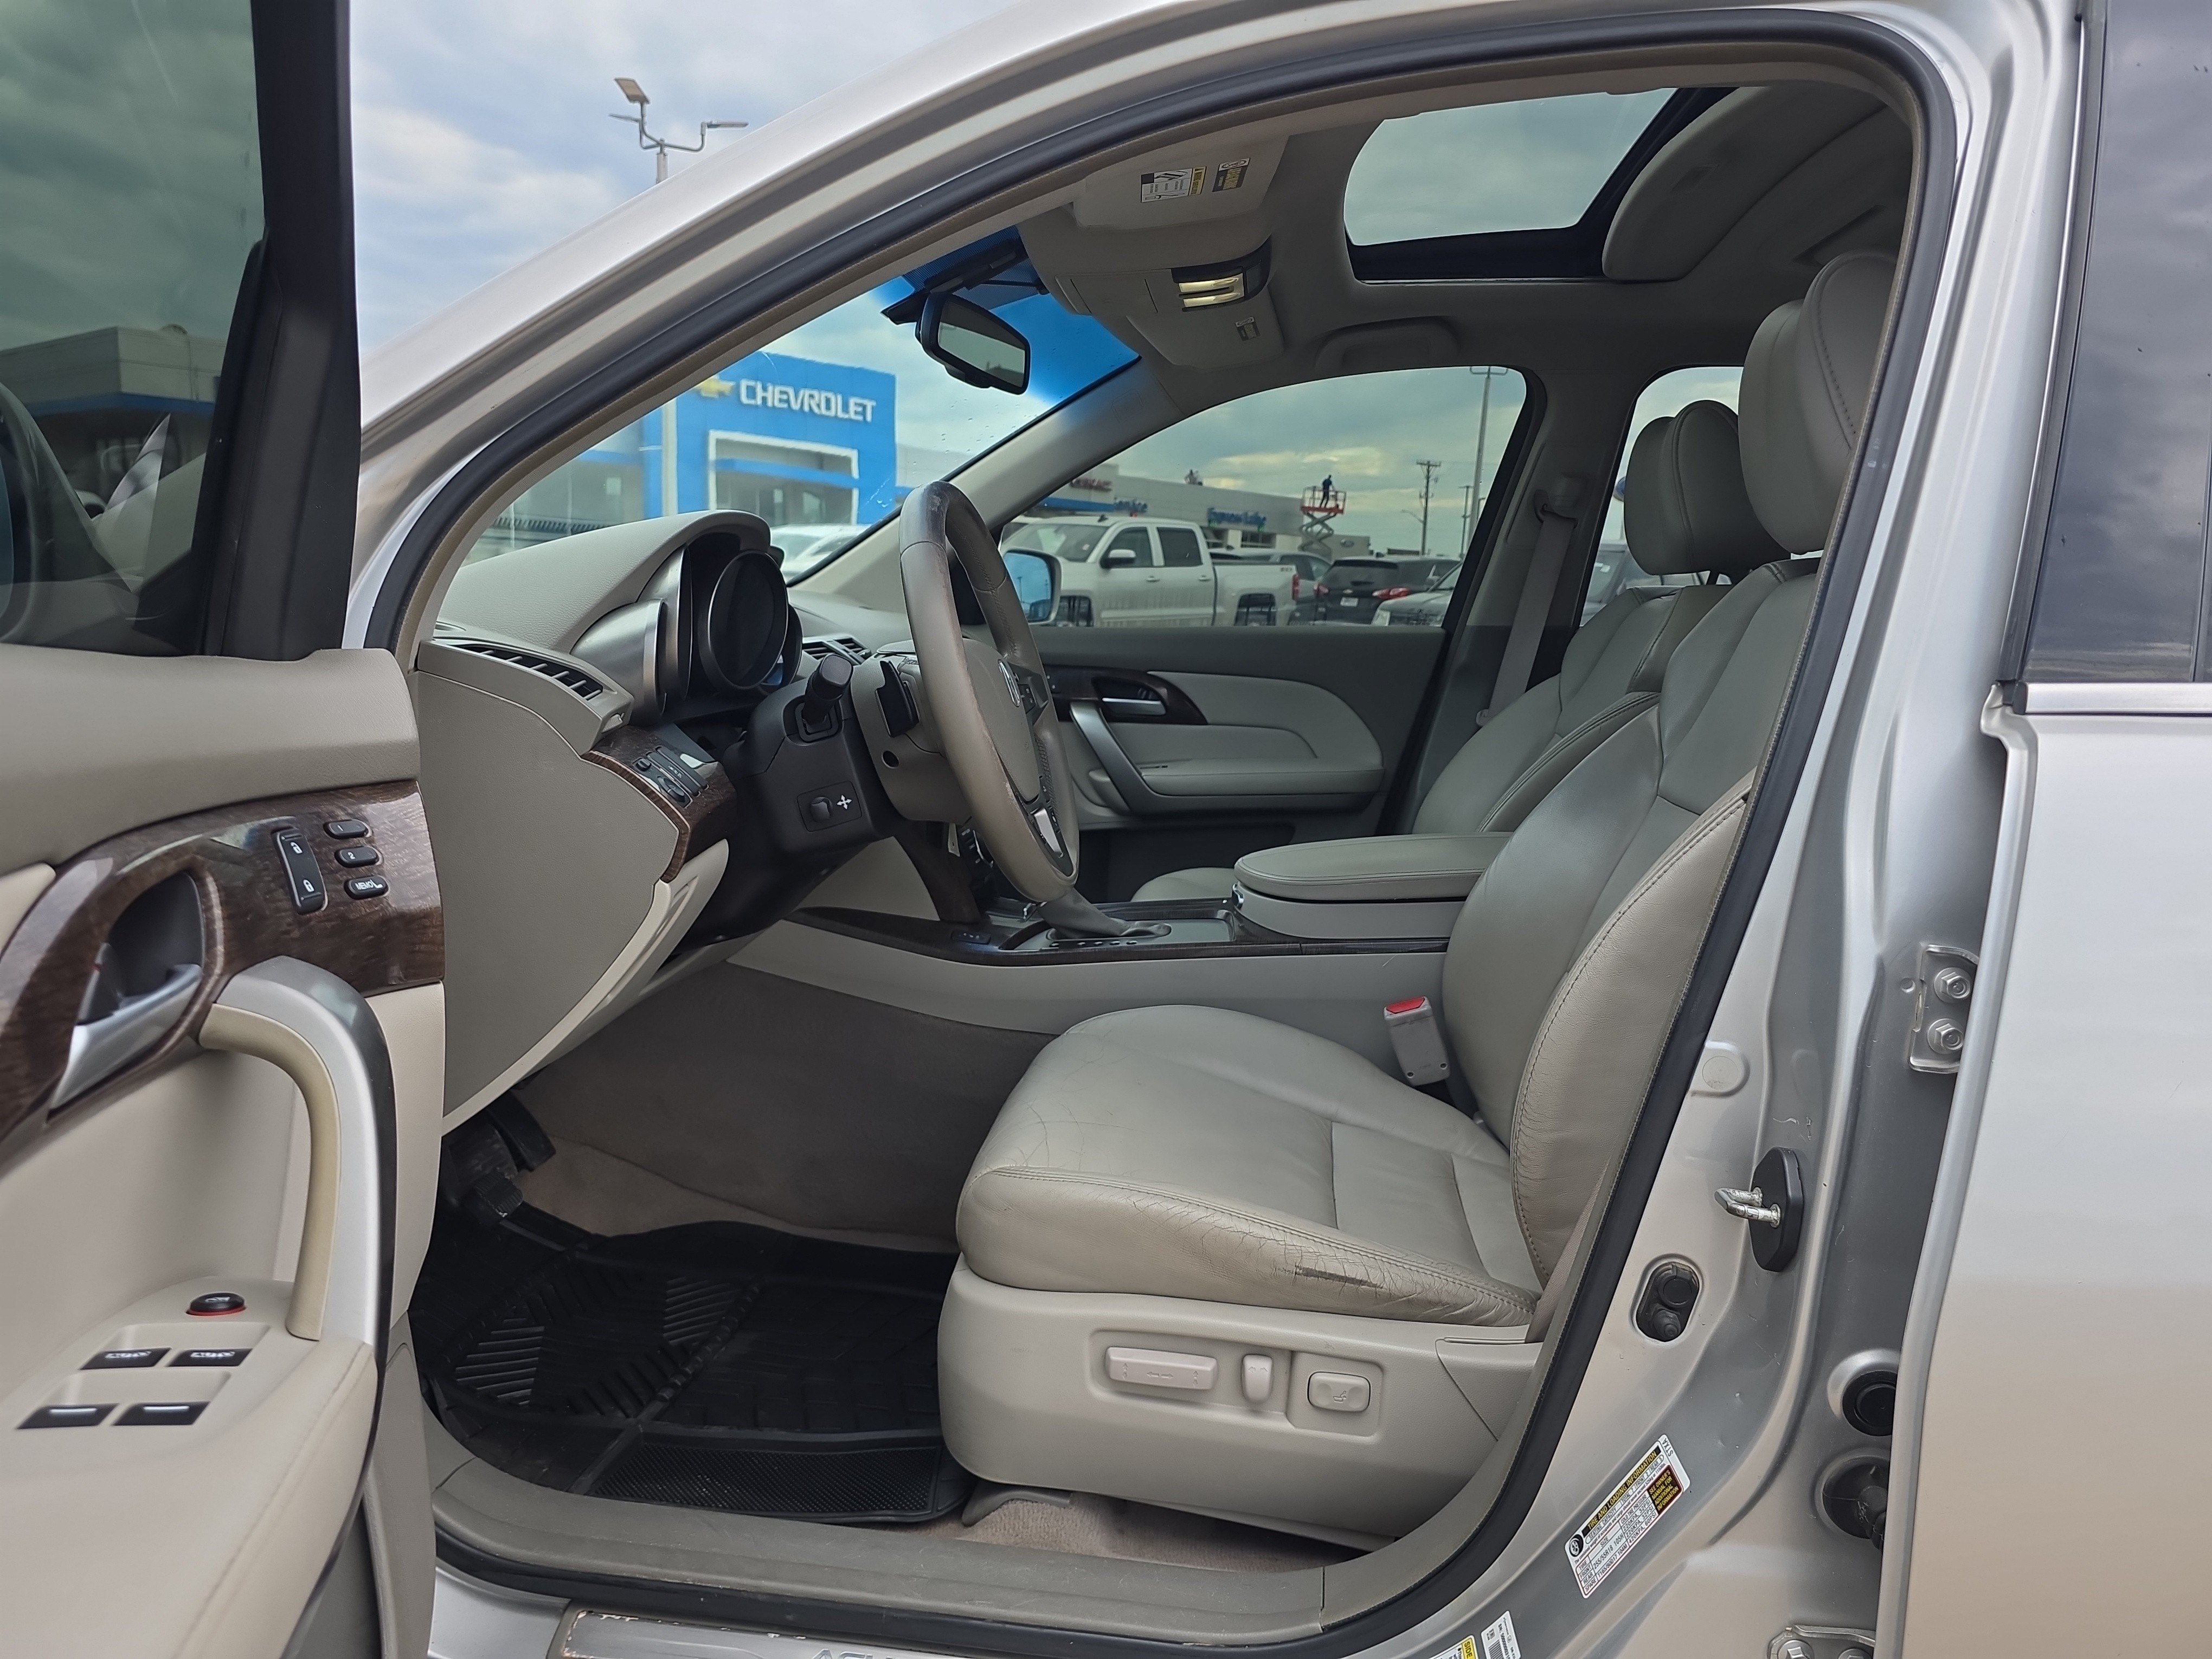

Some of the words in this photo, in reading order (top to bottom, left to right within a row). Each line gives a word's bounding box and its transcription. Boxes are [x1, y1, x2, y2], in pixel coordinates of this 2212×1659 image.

[740, 379, 876, 422] CHEVROLET
[355, 881, 372, 890] MEMO
[1662, 1438, 1674, 1457] STXA
[1655, 1469, 1670, 1488] OWNER'S
[1587, 1516, 1598, 1531] TIRE
[1597, 1504, 1608, 1520] AND
[1607, 1483, 1627, 1509] LOADING
[1626, 1450, 1657, 1487] INFORMATION
[1651, 1483, 1666, 1500] MANUAL
[1654, 1483, 1673, 1506] ADDITIONAL
[1657, 1485, 1679, 1512] INFORMATION
[1639, 1499, 1650, 1513] 32PSI
[1642, 1504, 1654, 1519] 32PSI
[1589, 1523, 1602, 1540] SEATING
[1602, 1506, 1617, 1525] CAPACITY
[1644, 1510, 1657, 1526] 60PSI
[1600, 1535, 1609, 1547] SIZE
[1593, 1544, 1613, 1570] 255/55R18
[1613, 1532, 1624, 1547] 105H
[1579, 1559, 1587, 1571] TIRE
[1579, 1564, 1591, 1579] FRONT
[1583, 1571, 1593, 1585] REAR
[1585, 1577, 1596, 1592] SPARE
[1464, 1641, 1472, 1659] SIDE
